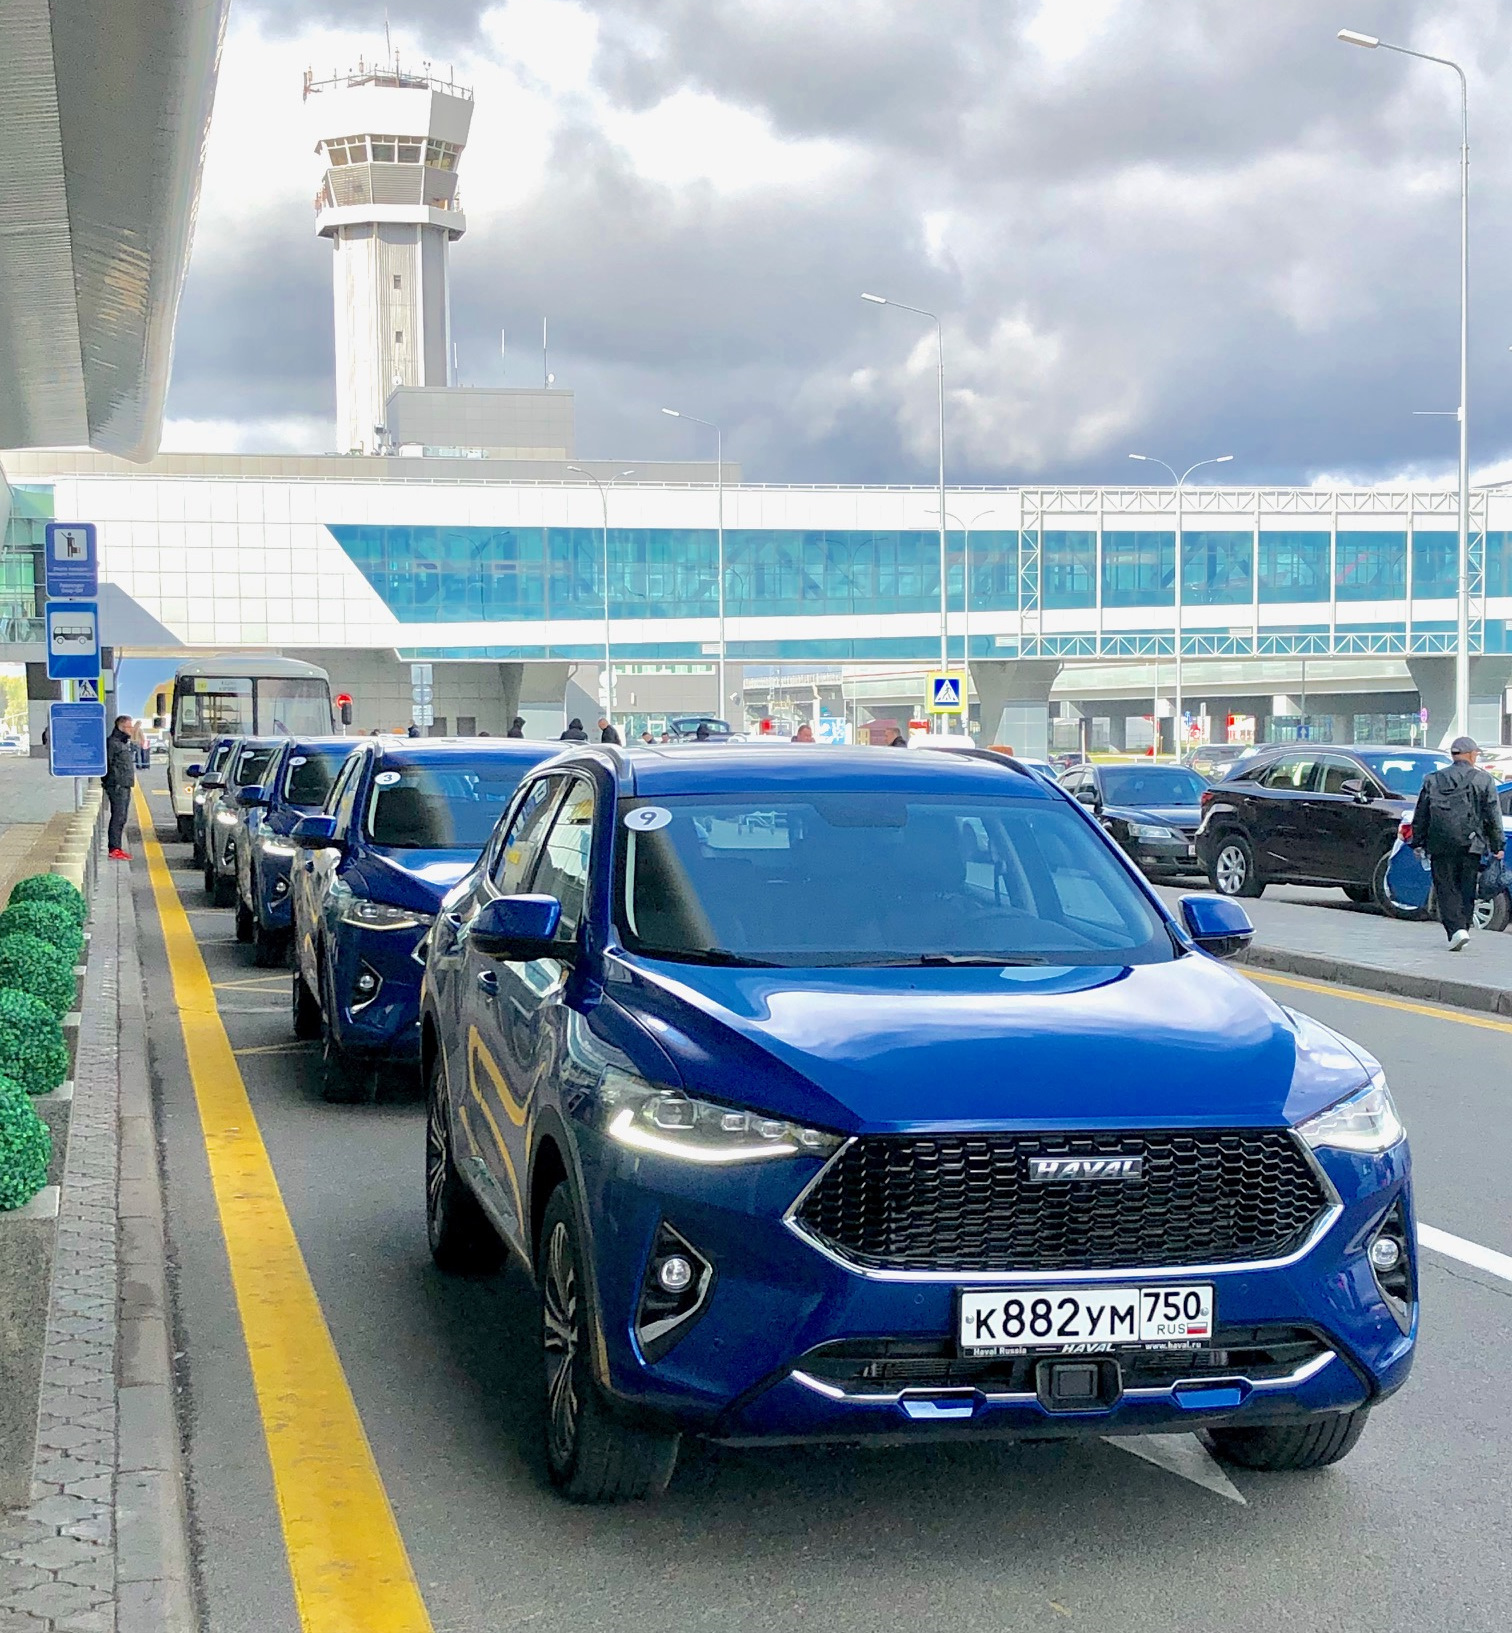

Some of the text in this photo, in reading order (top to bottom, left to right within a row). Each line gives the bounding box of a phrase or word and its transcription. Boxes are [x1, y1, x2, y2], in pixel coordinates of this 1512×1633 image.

[383, 774, 393, 782] 3
[640, 811, 657, 826] 9
[1035, 1160, 1140, 1179] HAVAL
[1143, 1290, 1201, 1323] 750
[1156, 1323, 1186, 1336] RUS
[973, 1346, 1027, 1356] Haval Russia
[1061, 1342, 1116, 1354] HAVAL
[1145, 1340, 1202, 1350] www.haval.ru
